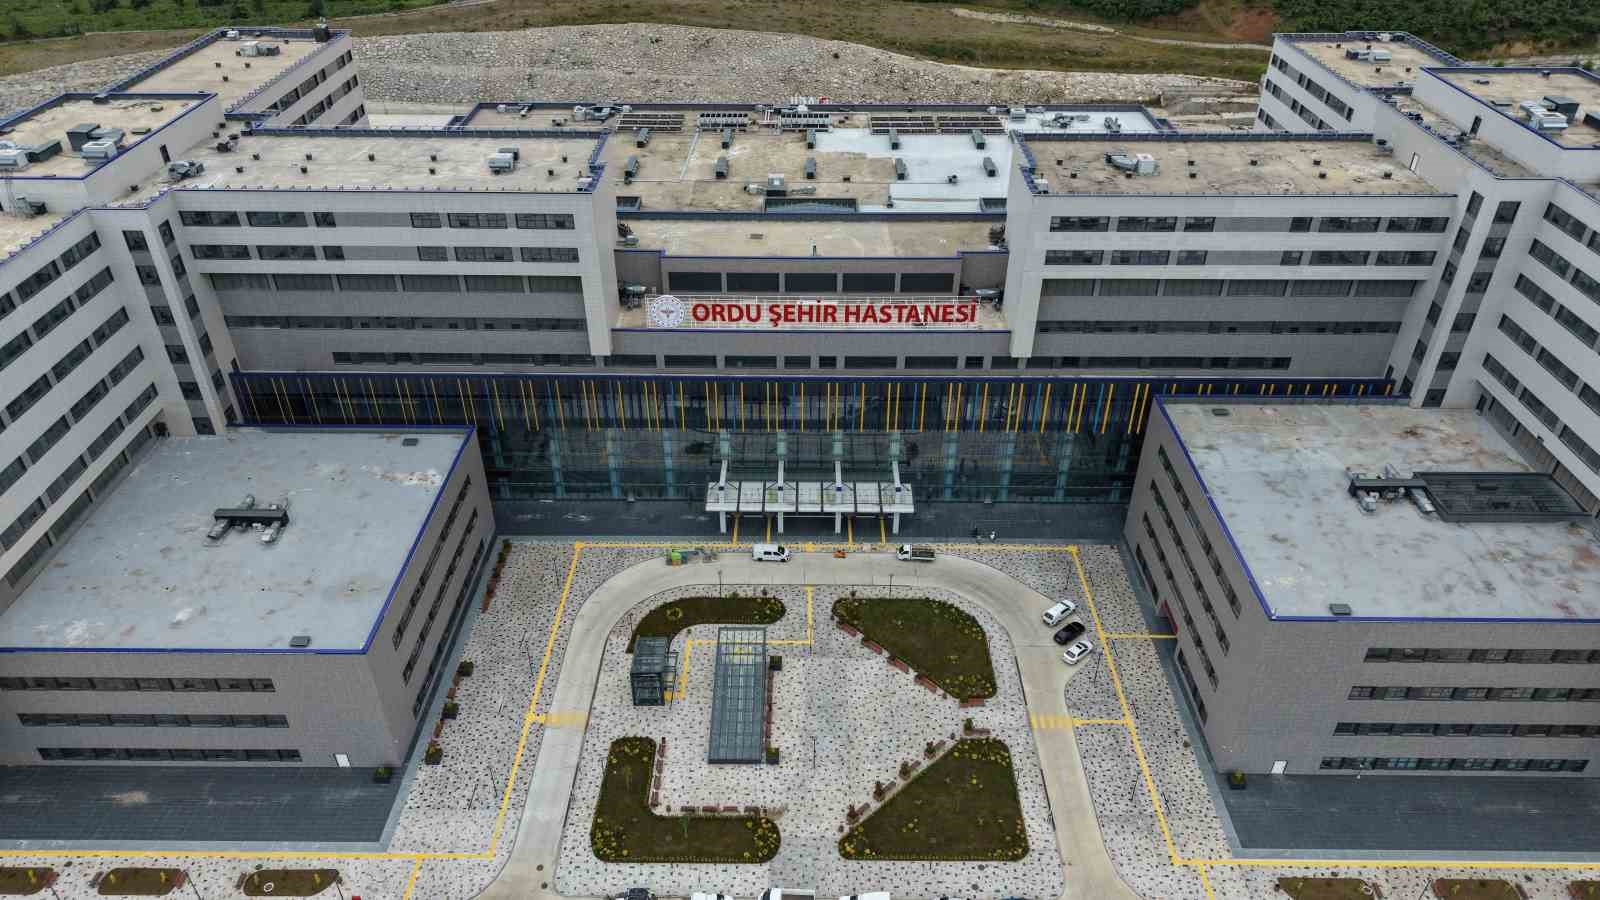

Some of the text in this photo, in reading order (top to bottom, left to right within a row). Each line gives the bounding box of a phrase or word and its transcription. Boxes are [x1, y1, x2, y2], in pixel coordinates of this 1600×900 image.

[692, 303, 762, 323] ORDU
[768, 299, 837, 326] ŞEHİR
[844, 297, 977, 323] HASTANESİ
